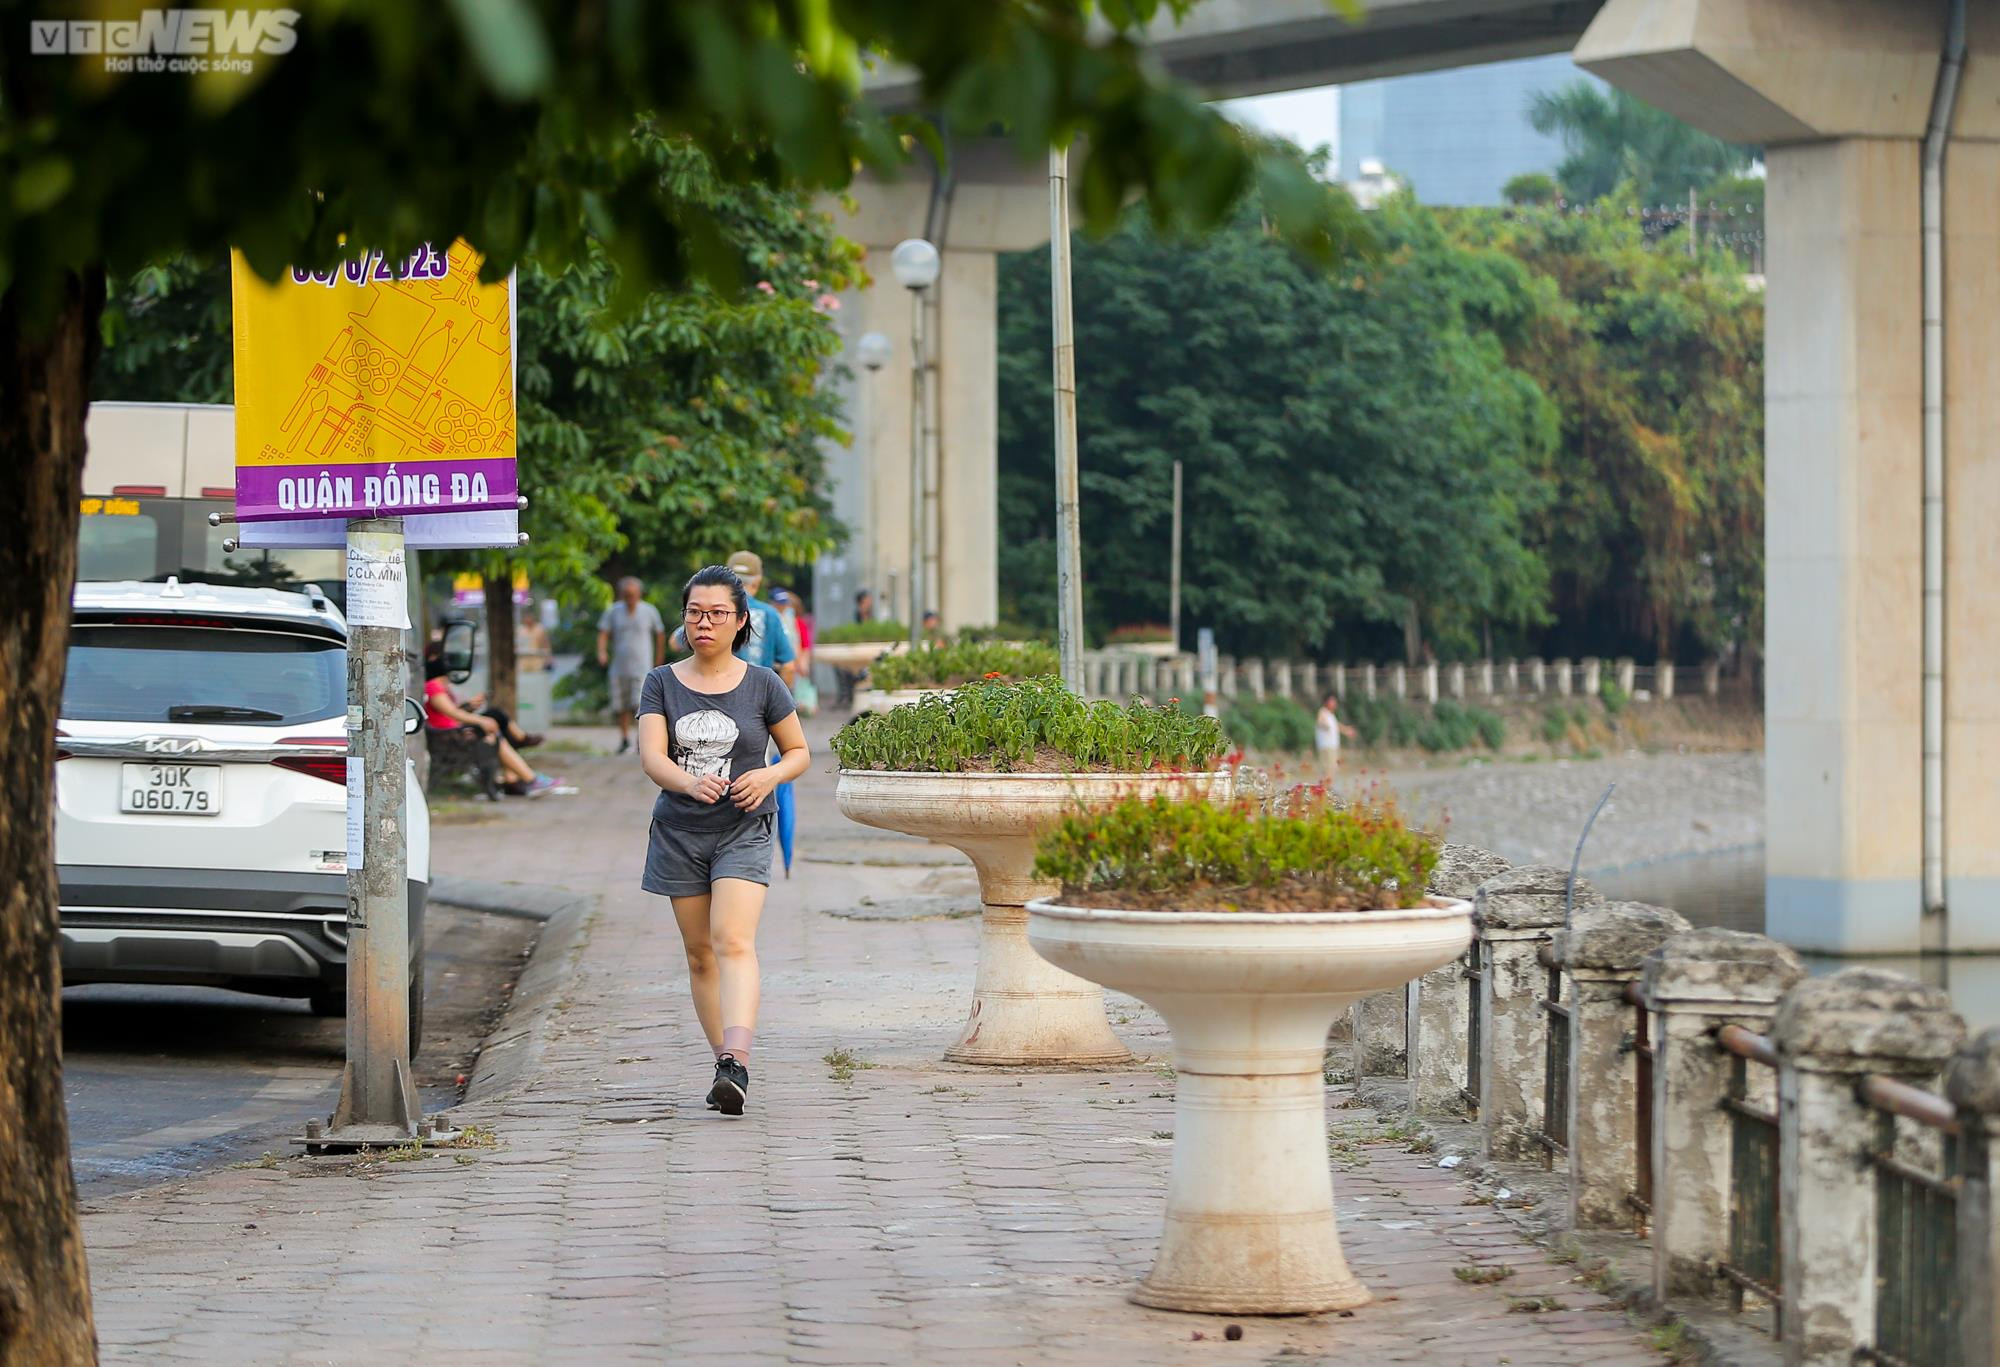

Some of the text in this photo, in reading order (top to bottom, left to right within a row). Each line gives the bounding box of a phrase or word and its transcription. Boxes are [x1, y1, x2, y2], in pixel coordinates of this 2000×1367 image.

[277, 462, 490, 515] QUẬN ĐỐNG ĐA
[150, 765, 193, 788] 30K
[132, 788, 209, 811] 060.79
